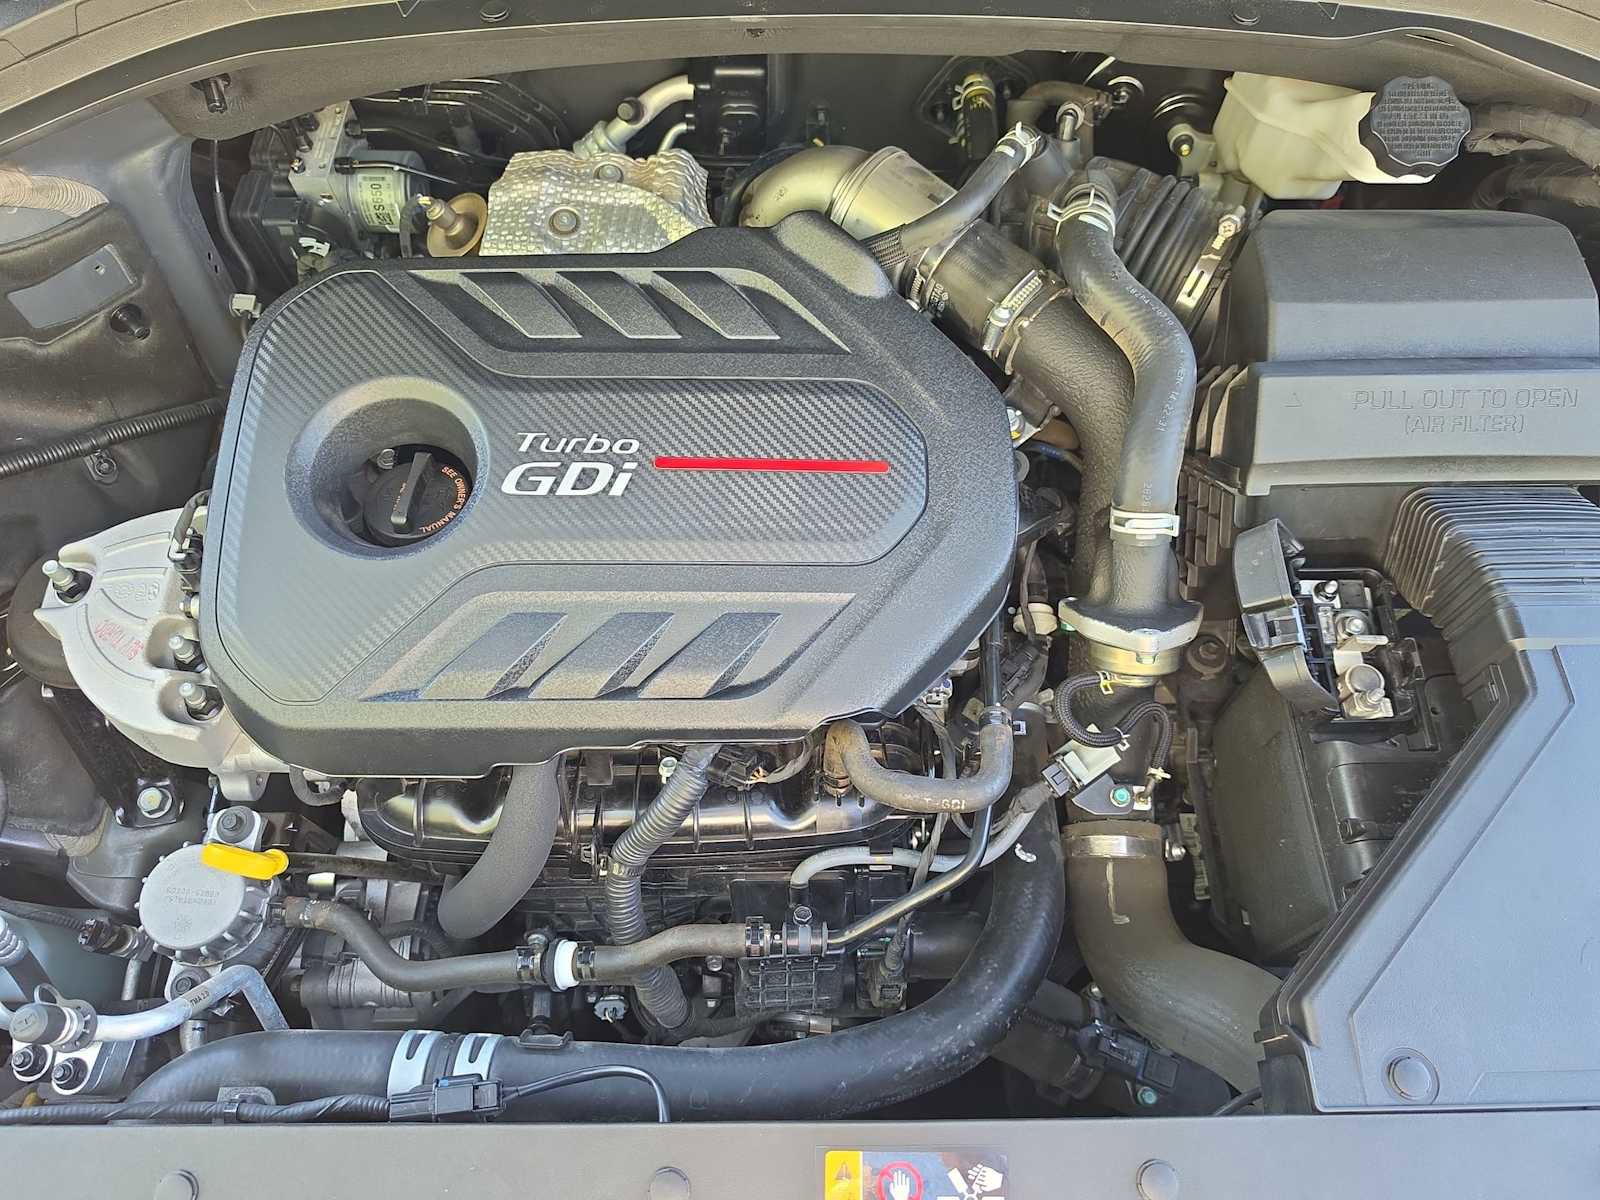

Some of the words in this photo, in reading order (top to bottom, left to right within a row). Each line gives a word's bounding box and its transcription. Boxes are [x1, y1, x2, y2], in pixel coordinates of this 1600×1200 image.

[1352, 389, 1414, 410] PULL
[1422, 389, 1471, 409] OUT
[1477, 388, 1508, 408] TO
[1515, 387, 1578, 408] OPEN
[1404, 415, 1446, 434] (AIR
[1450, 414, 1526, 433] FILTER)
[517, 432, 640, 454] Turbo
[441, 466, 458, 480] SEE
[501, 461, 638, 496] GDi
[453, 478, 467, 511] OWNER'S
[419, 511, 457, 533] MANUAL
